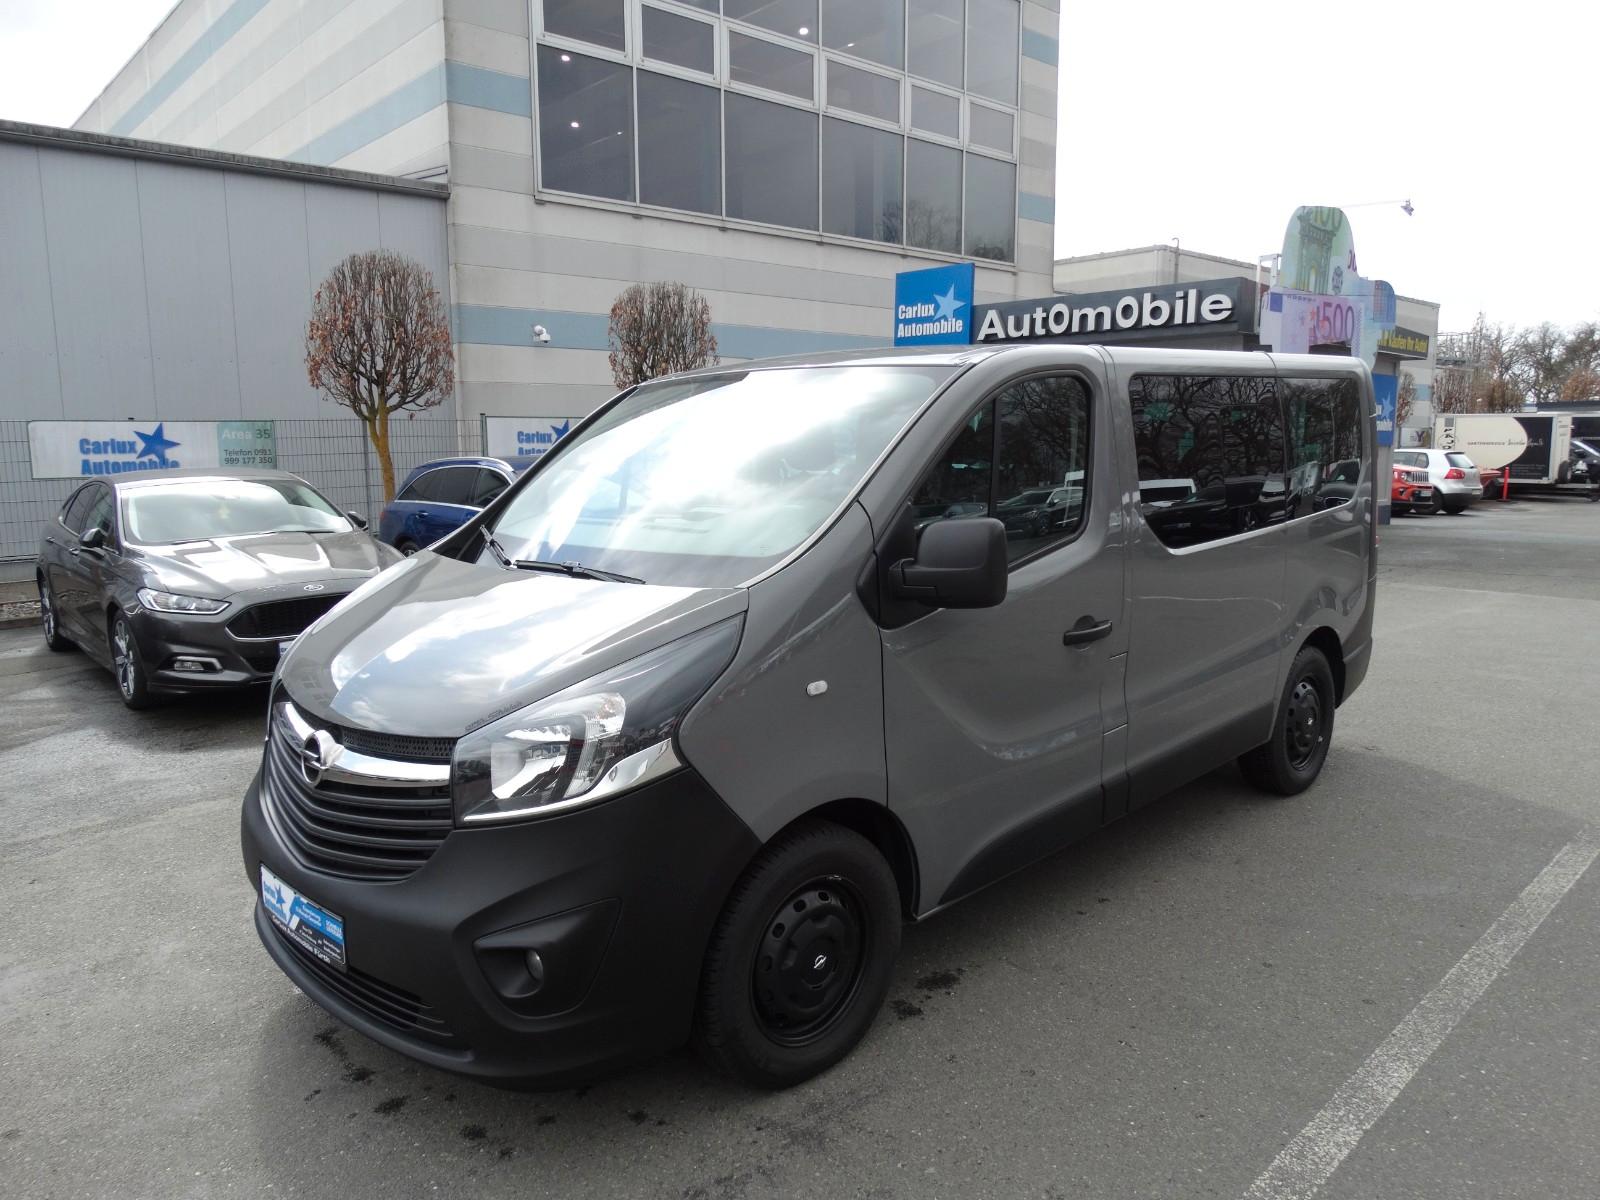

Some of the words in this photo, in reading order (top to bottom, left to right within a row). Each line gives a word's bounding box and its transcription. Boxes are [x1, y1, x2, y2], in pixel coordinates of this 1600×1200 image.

[898, 303, 935, 319] Carlux
[897, 318, 963, 338] Automobile
[222, 429, 252, 440] Area
[255, 429, 272, 439] 35
[517, 431, 553, 444] Carlux
[79, 438, 138, 455] Carlux
